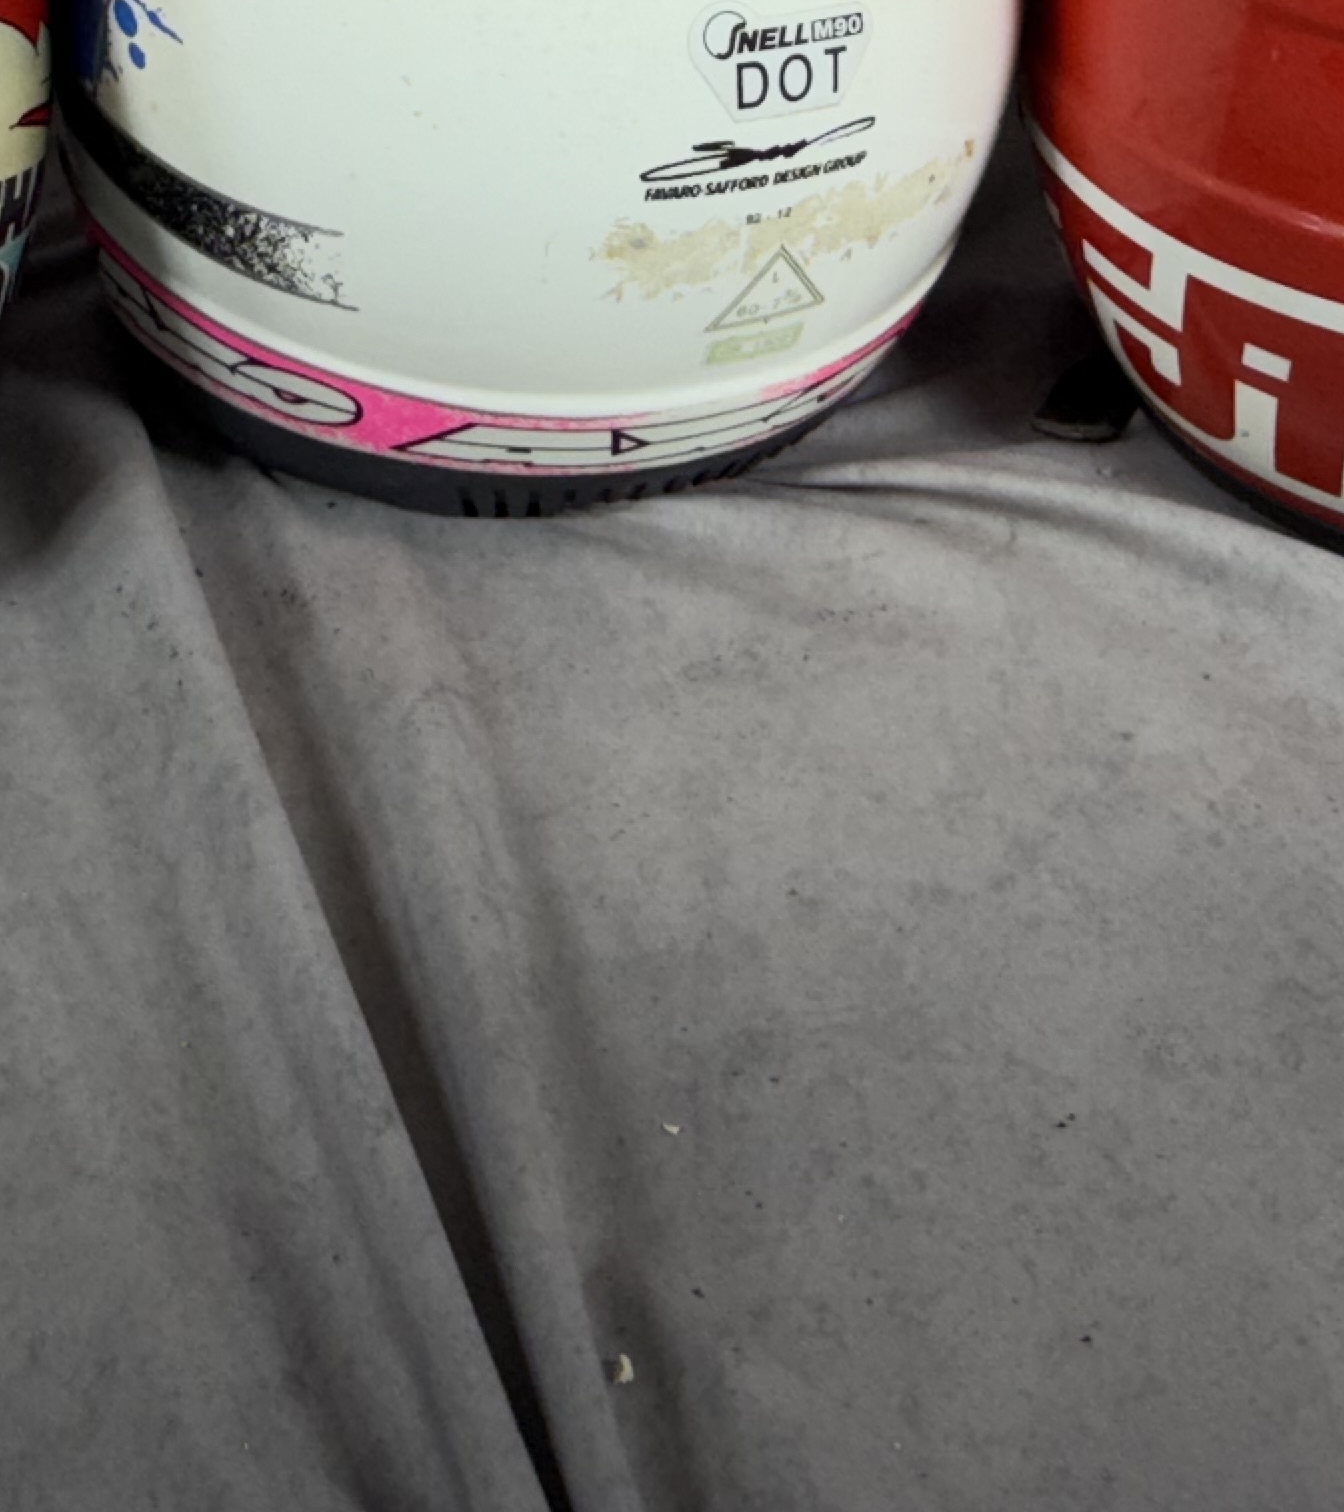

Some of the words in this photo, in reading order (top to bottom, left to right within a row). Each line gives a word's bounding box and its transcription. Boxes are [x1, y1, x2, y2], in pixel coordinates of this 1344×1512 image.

[703, 10, 809, 59] SNELL
[813, 12, 863, 41] M90
[737, 45, 847, 110] DOT
[773, 163, 821, 185] DESIGN
[822, 149, 867, 174] GROUP
